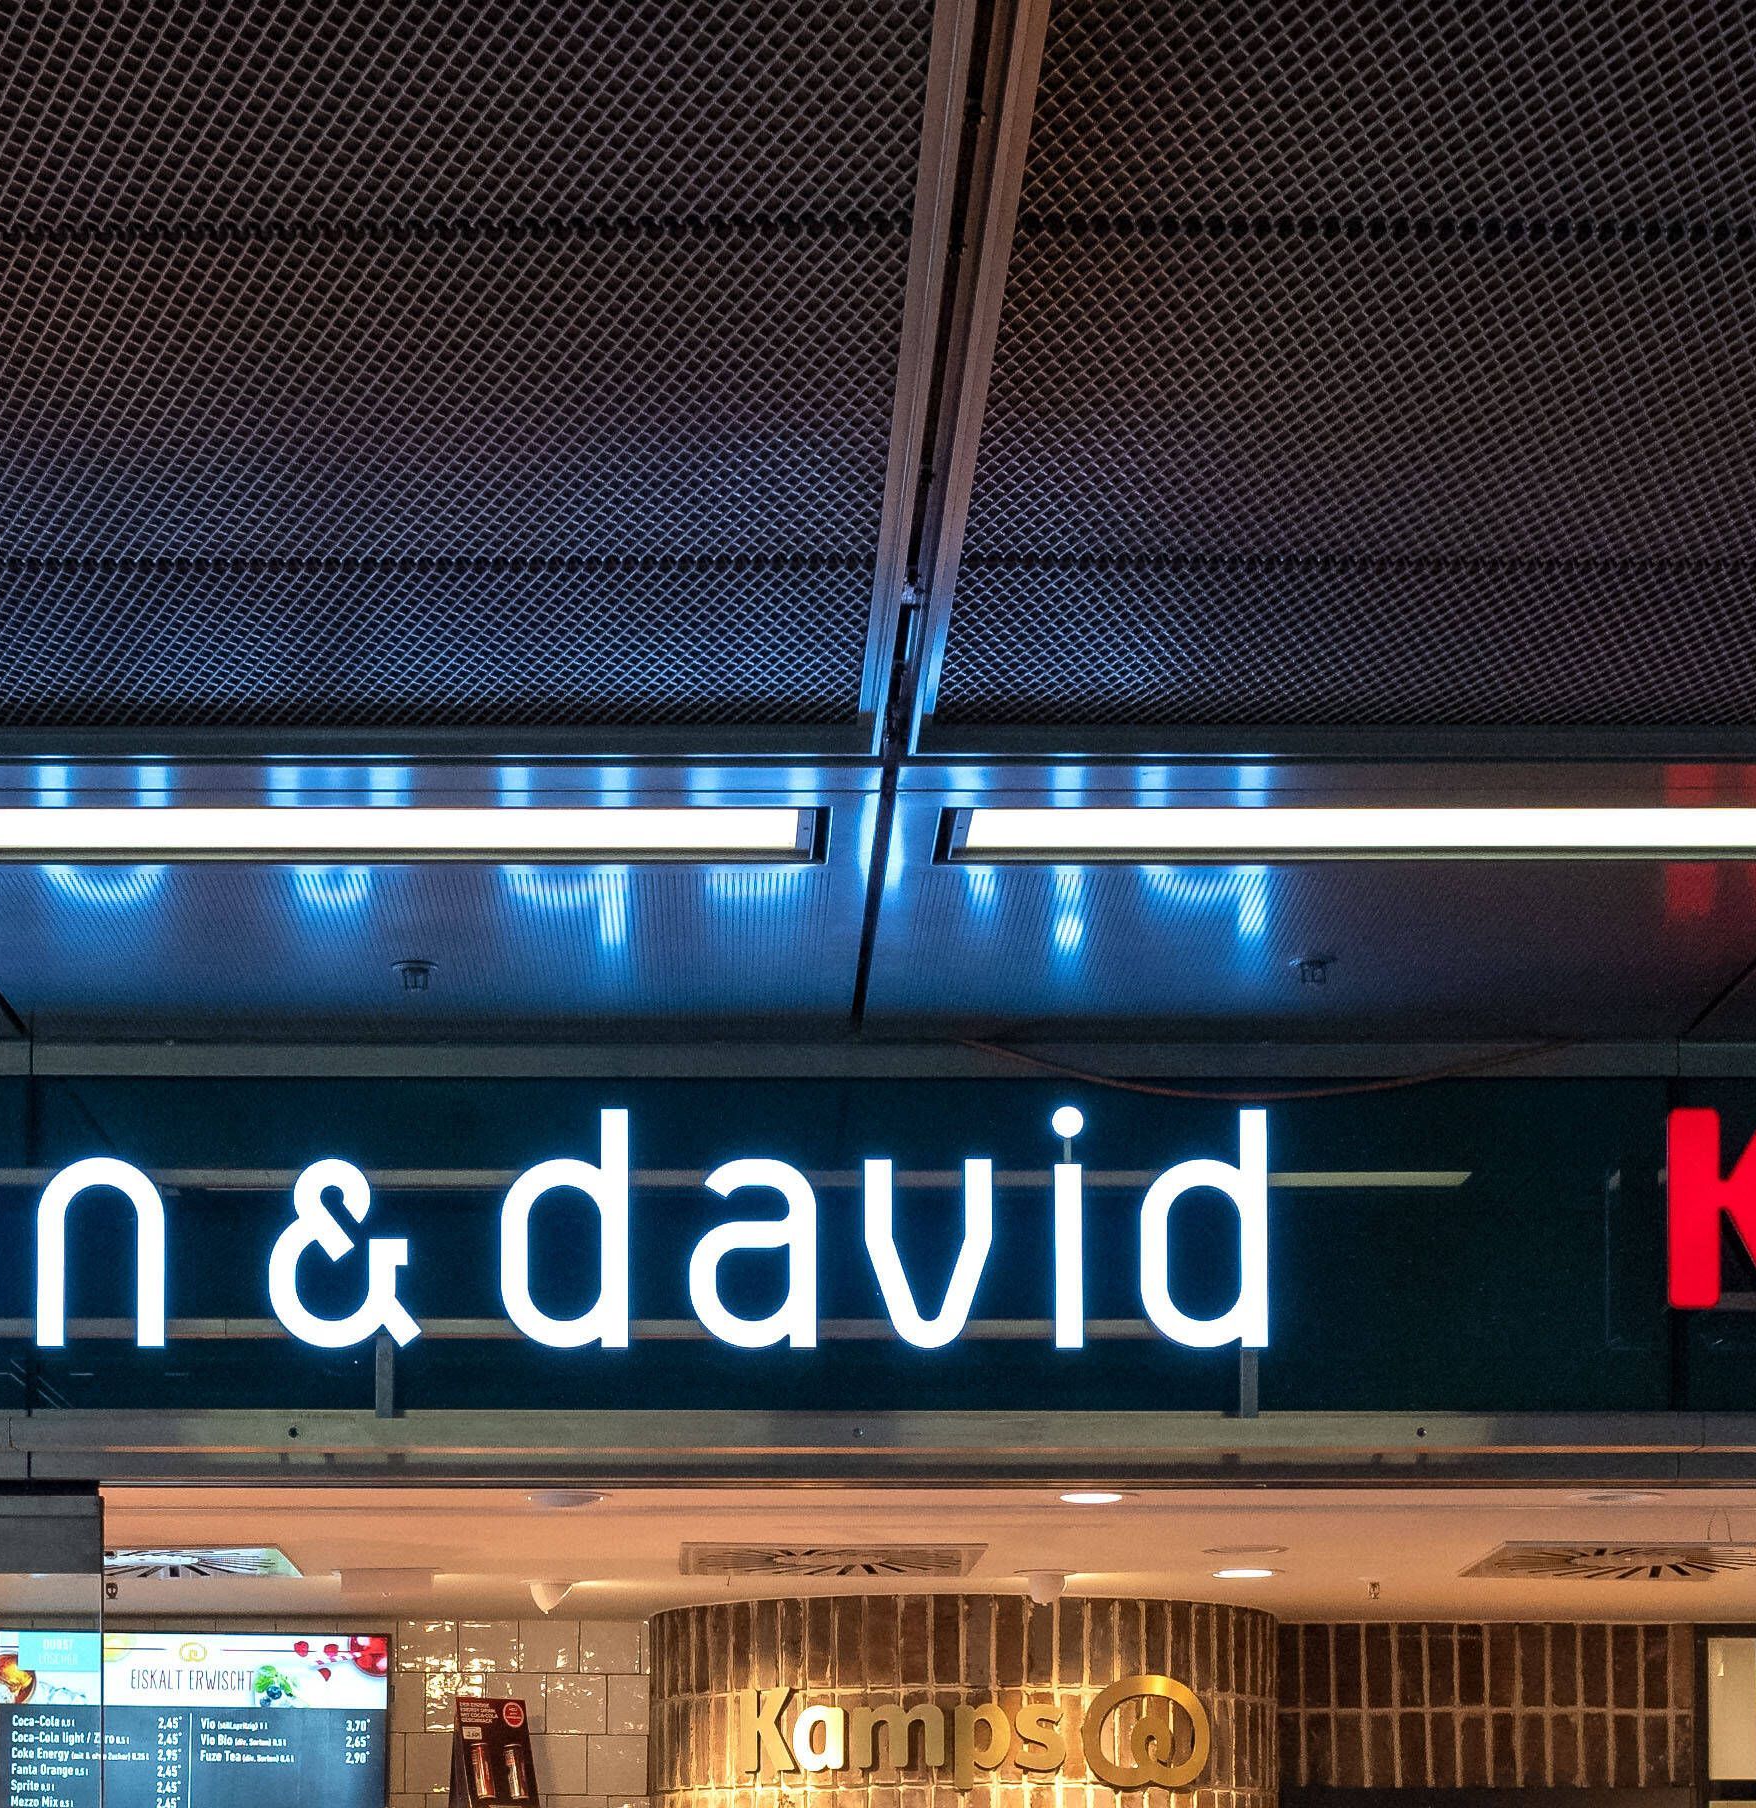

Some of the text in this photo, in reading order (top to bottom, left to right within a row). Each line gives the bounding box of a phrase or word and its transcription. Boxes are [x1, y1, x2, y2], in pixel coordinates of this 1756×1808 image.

[267, 1158, 420, 1349] &
[500, 1106, 1270, 1350] david
[130, 1669, 255, 1691] EISKALT ERWISCHT
[11, 1714, 60, 1727] Coca-Cola
[200, 1717, 216, 1730] Vio
[11, 1730, 60, 1743] Coca-Cola
[62, 1730, 85, 1745] light
[94, 1731, 116, 1744] Zro
[200, 1733, 216, 1746] Vio
[217, 1734, 233, 1746] Bio
[743, 1686, 1068, 1791] Kamps
[11, 1747, 35, 1760] Coke
[37, 1747, 69, 1761] Energy
[199, 1749, 222, 1762] Fuze
[224, 1750, 241, 1762] Tea
[11, 1763, 38, 1775] Fanta
[40, 1763, 74, 1778] Orange
[10, 1779, 40, 1793] Sprite
[10, 1796, 39, 1808] Mezzo
[41, 1796, 58, 1808] Mix
